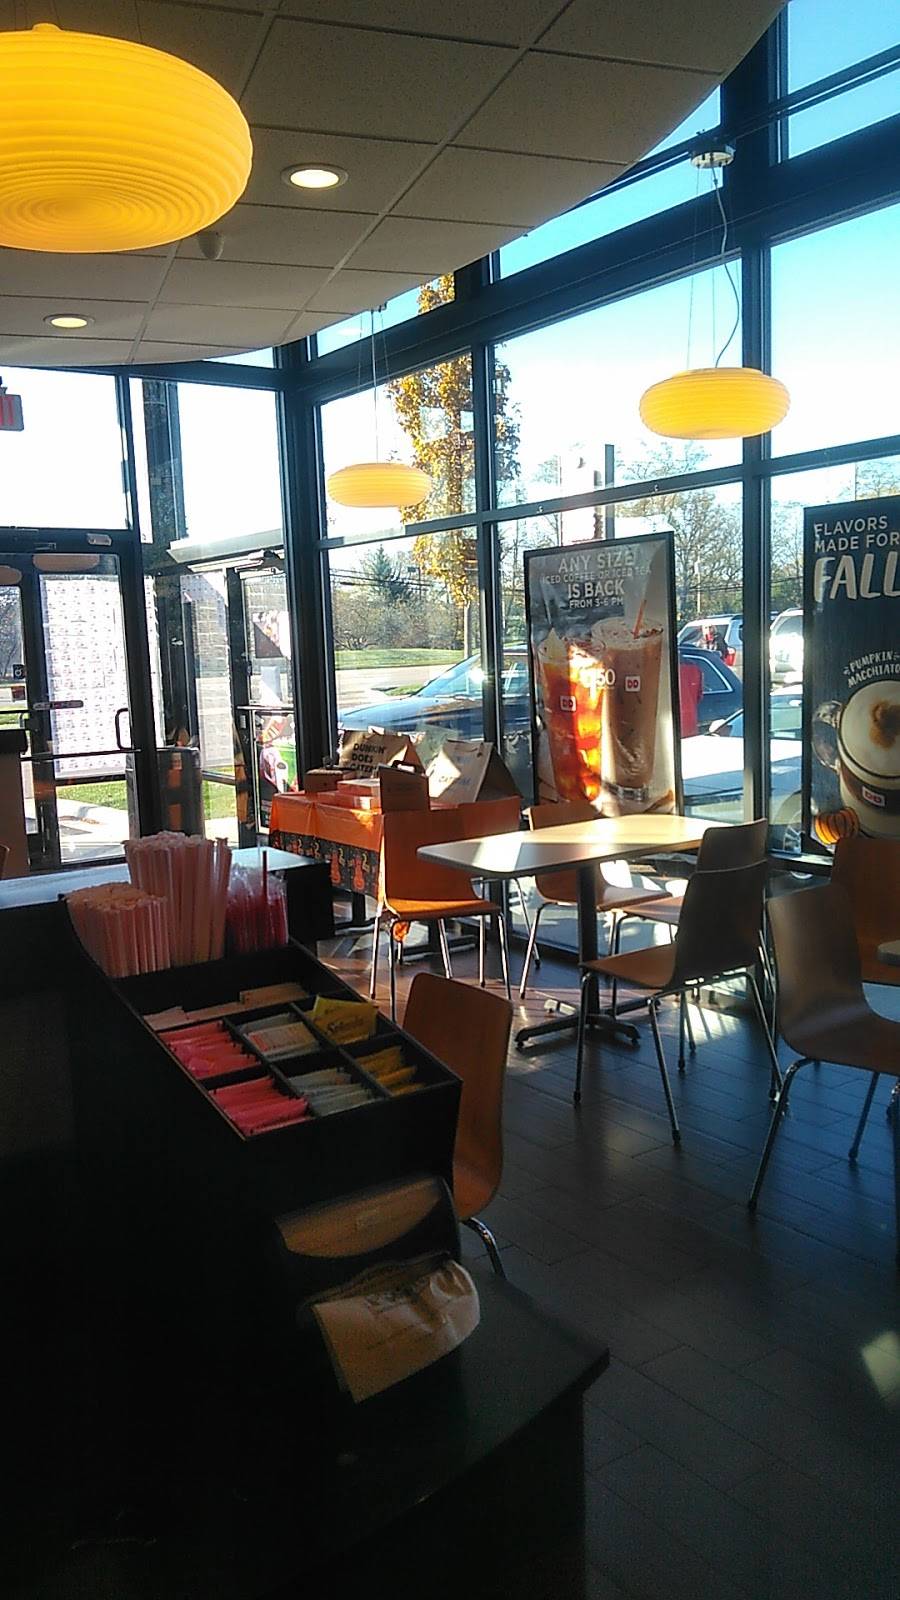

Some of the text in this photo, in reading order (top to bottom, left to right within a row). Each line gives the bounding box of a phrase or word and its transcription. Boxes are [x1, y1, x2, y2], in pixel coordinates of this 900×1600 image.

[814, 516, 888, 535] FLAVORS
[815, 532, 900, 553] MADE FOR
[558, 549, 635, 573] ANY SIZE
[563, 571, 595, 583] COFFEE
[814, 551, 900, 603] FALL
[568, 580, 625, 599] IS BACK
[569, 599, 593, 609] FROM
[611, 598, 624, 607] PM
[850, 651, 893, 672] PUMPKIN
[848, 664, 900, 688] MACCHIATO
[352, 753, 373, 763] DOES
